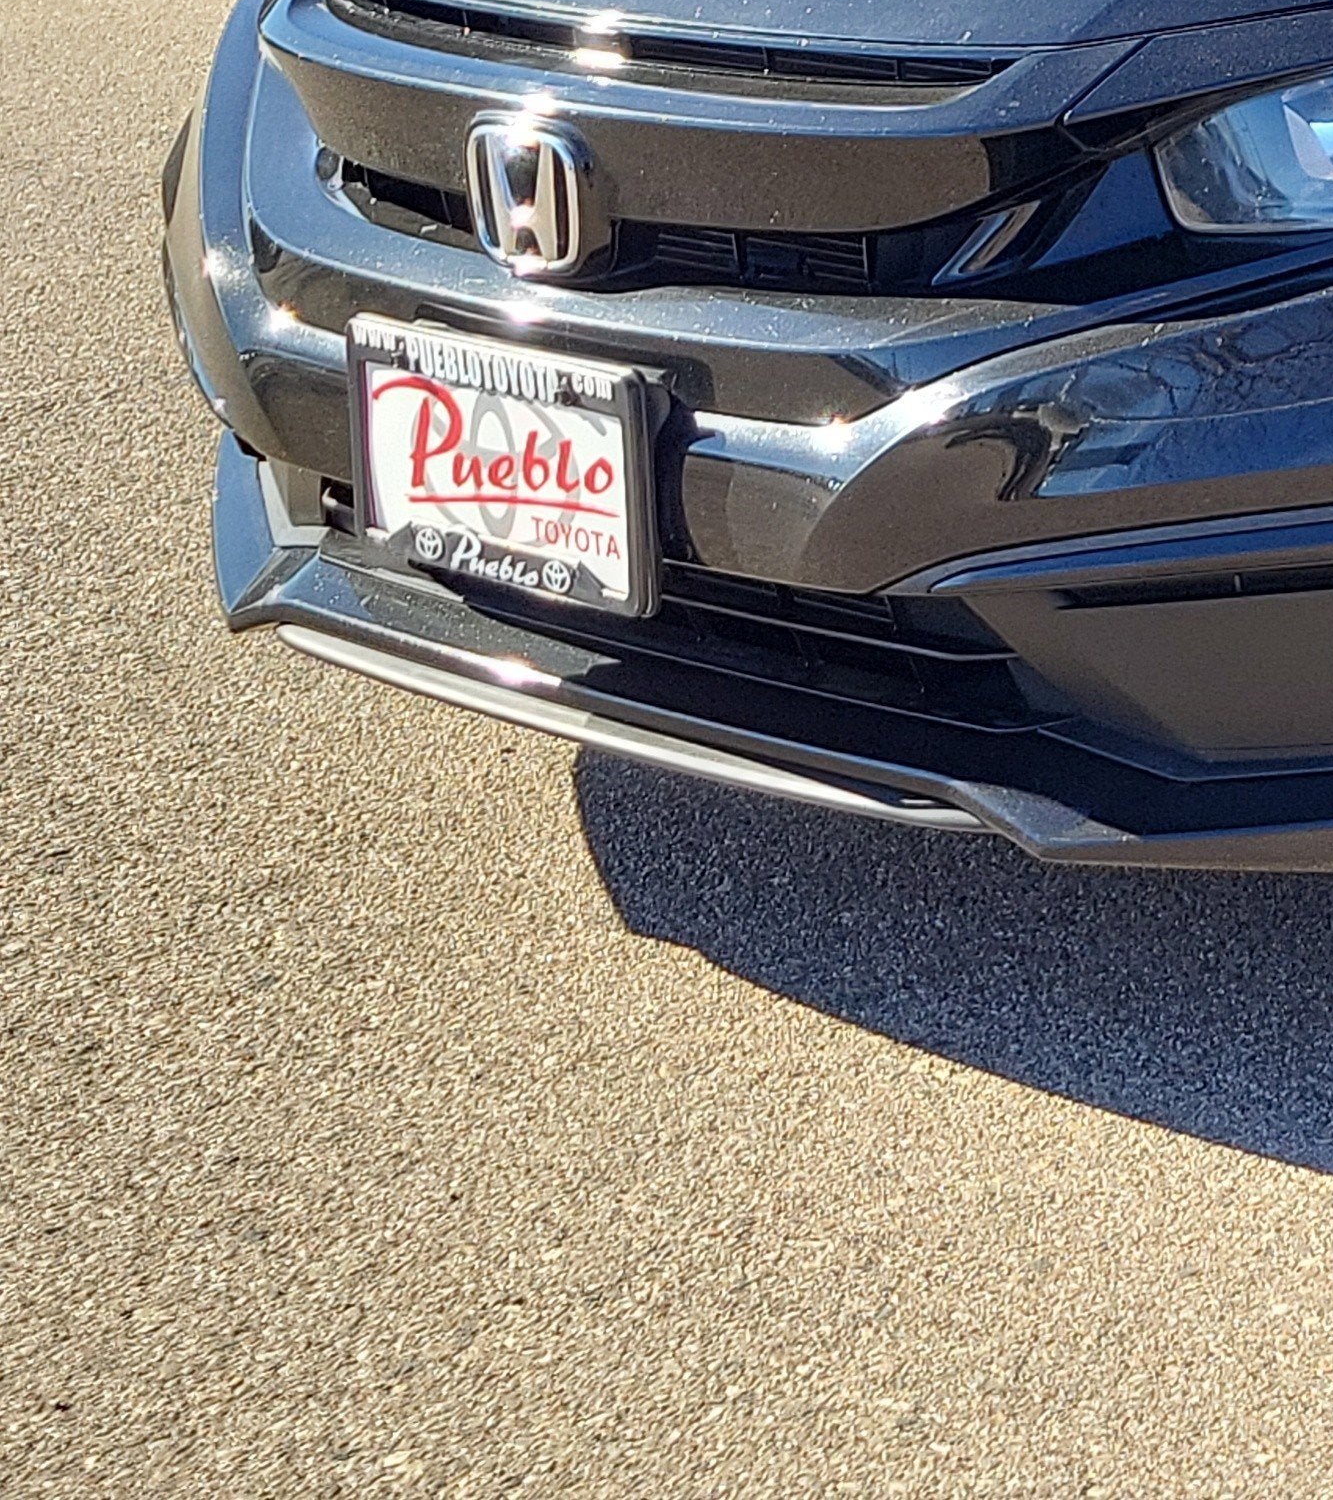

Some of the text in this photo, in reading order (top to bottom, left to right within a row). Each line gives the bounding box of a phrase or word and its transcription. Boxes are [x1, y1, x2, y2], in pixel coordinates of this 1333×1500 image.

[372, 376, 614, 495] Pueblo
[444, 523, 539, 587] Pueblo
[531, 516, 622, 561] TOYOTA
